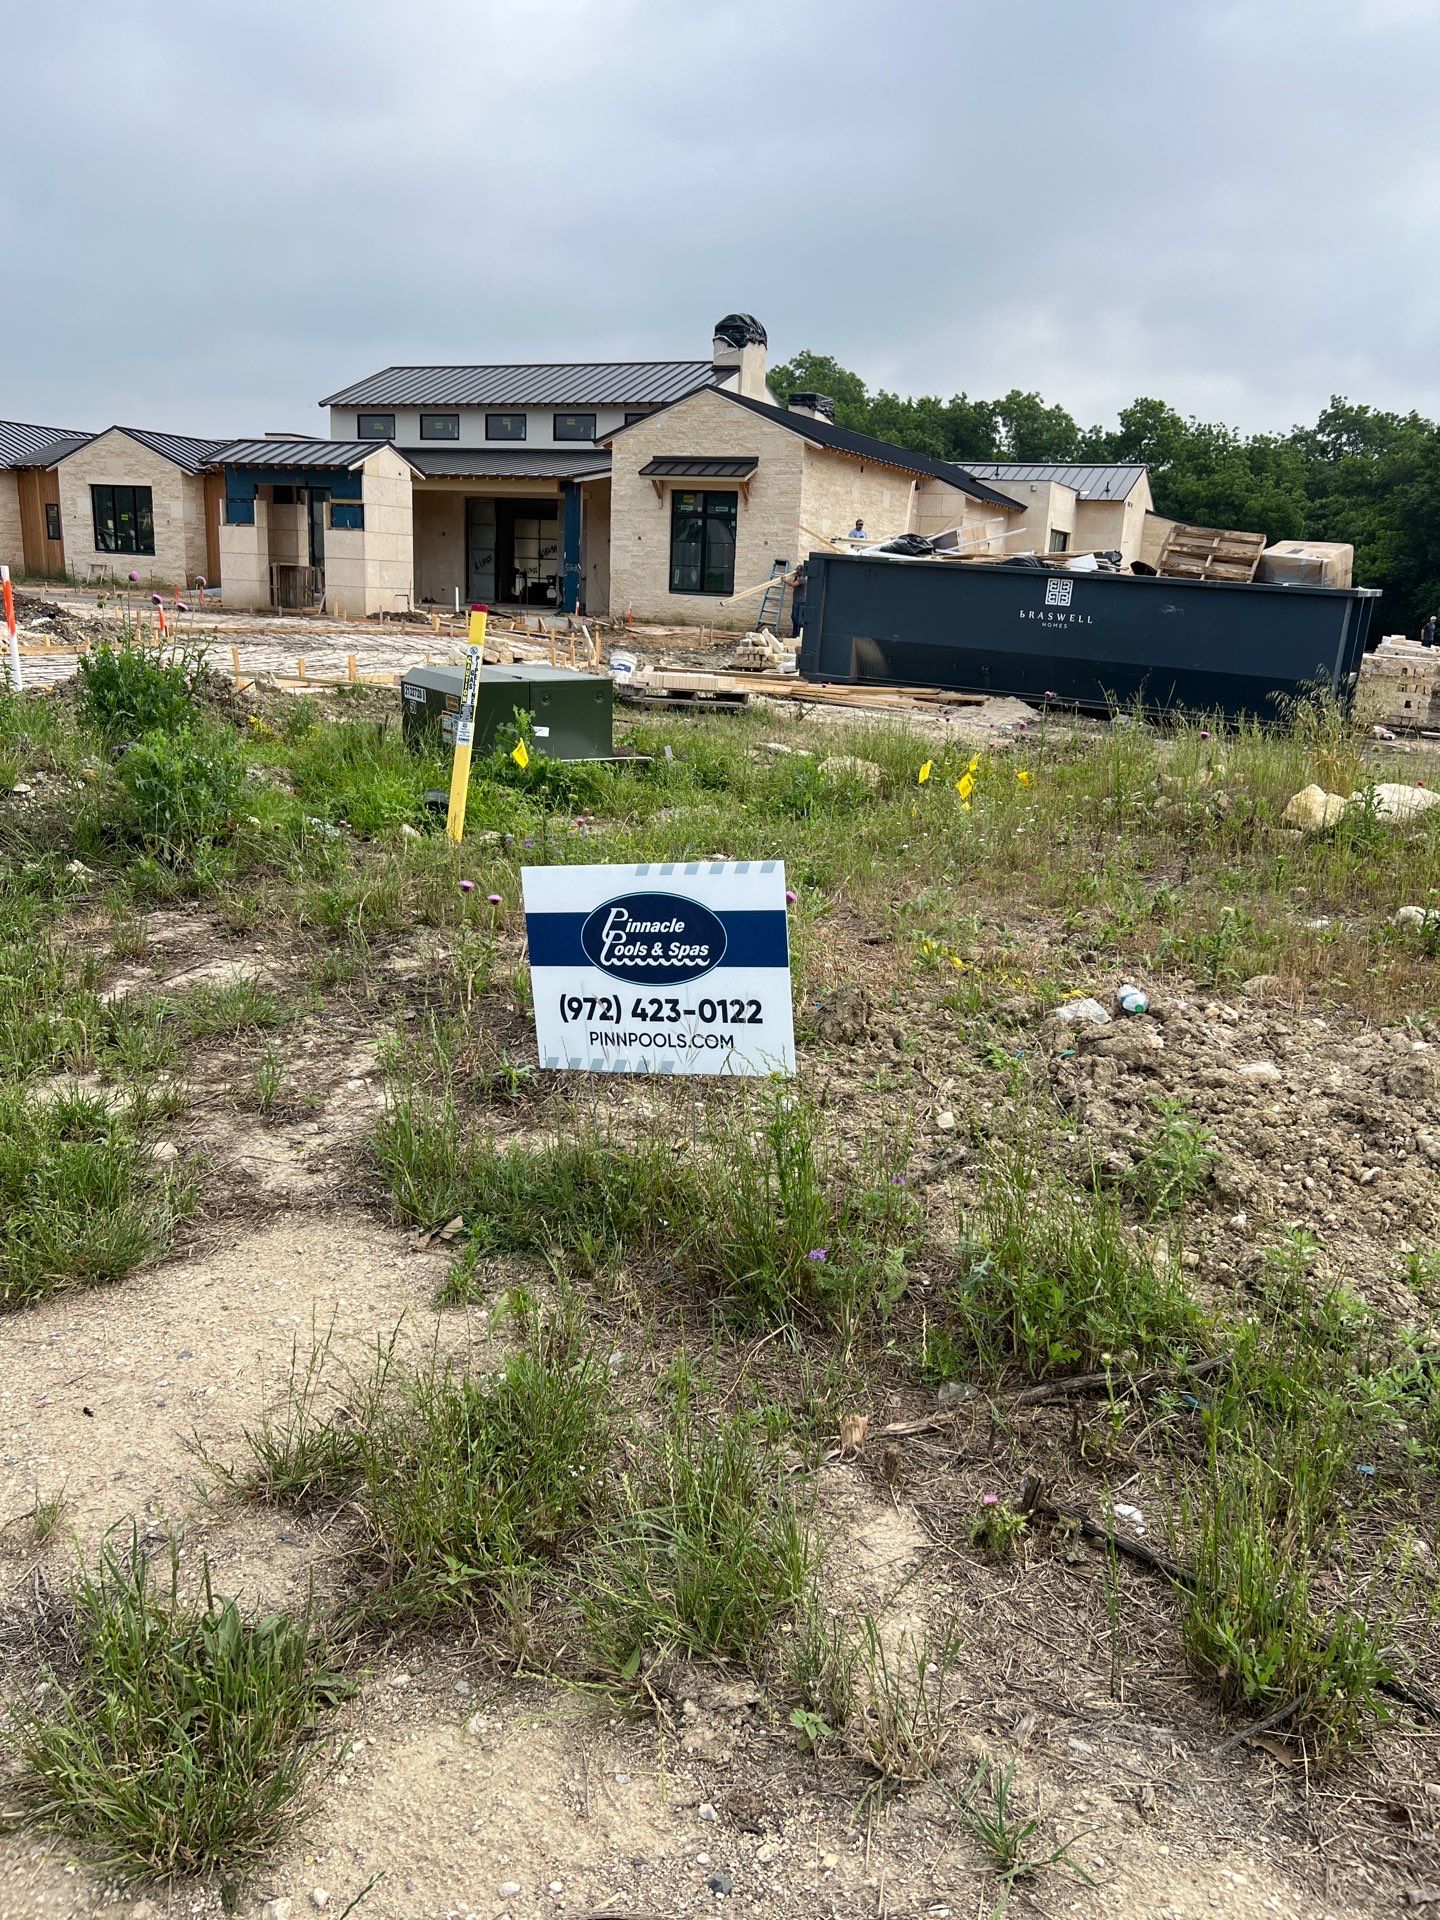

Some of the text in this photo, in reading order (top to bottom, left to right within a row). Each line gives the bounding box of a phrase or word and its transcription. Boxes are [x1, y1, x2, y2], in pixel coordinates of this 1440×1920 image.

[461, 655, 472, 704] CAUTION
[471, 655, 480, 704] PIPELINE
[602, 907, 685, 942] Pinnacle
[600, 931, 710, 963] Pools & Spas
[559, 994, 763, 1024] (972) 423-0122
[589, 1031, 735, 1049] PINNPOOLS.COM
